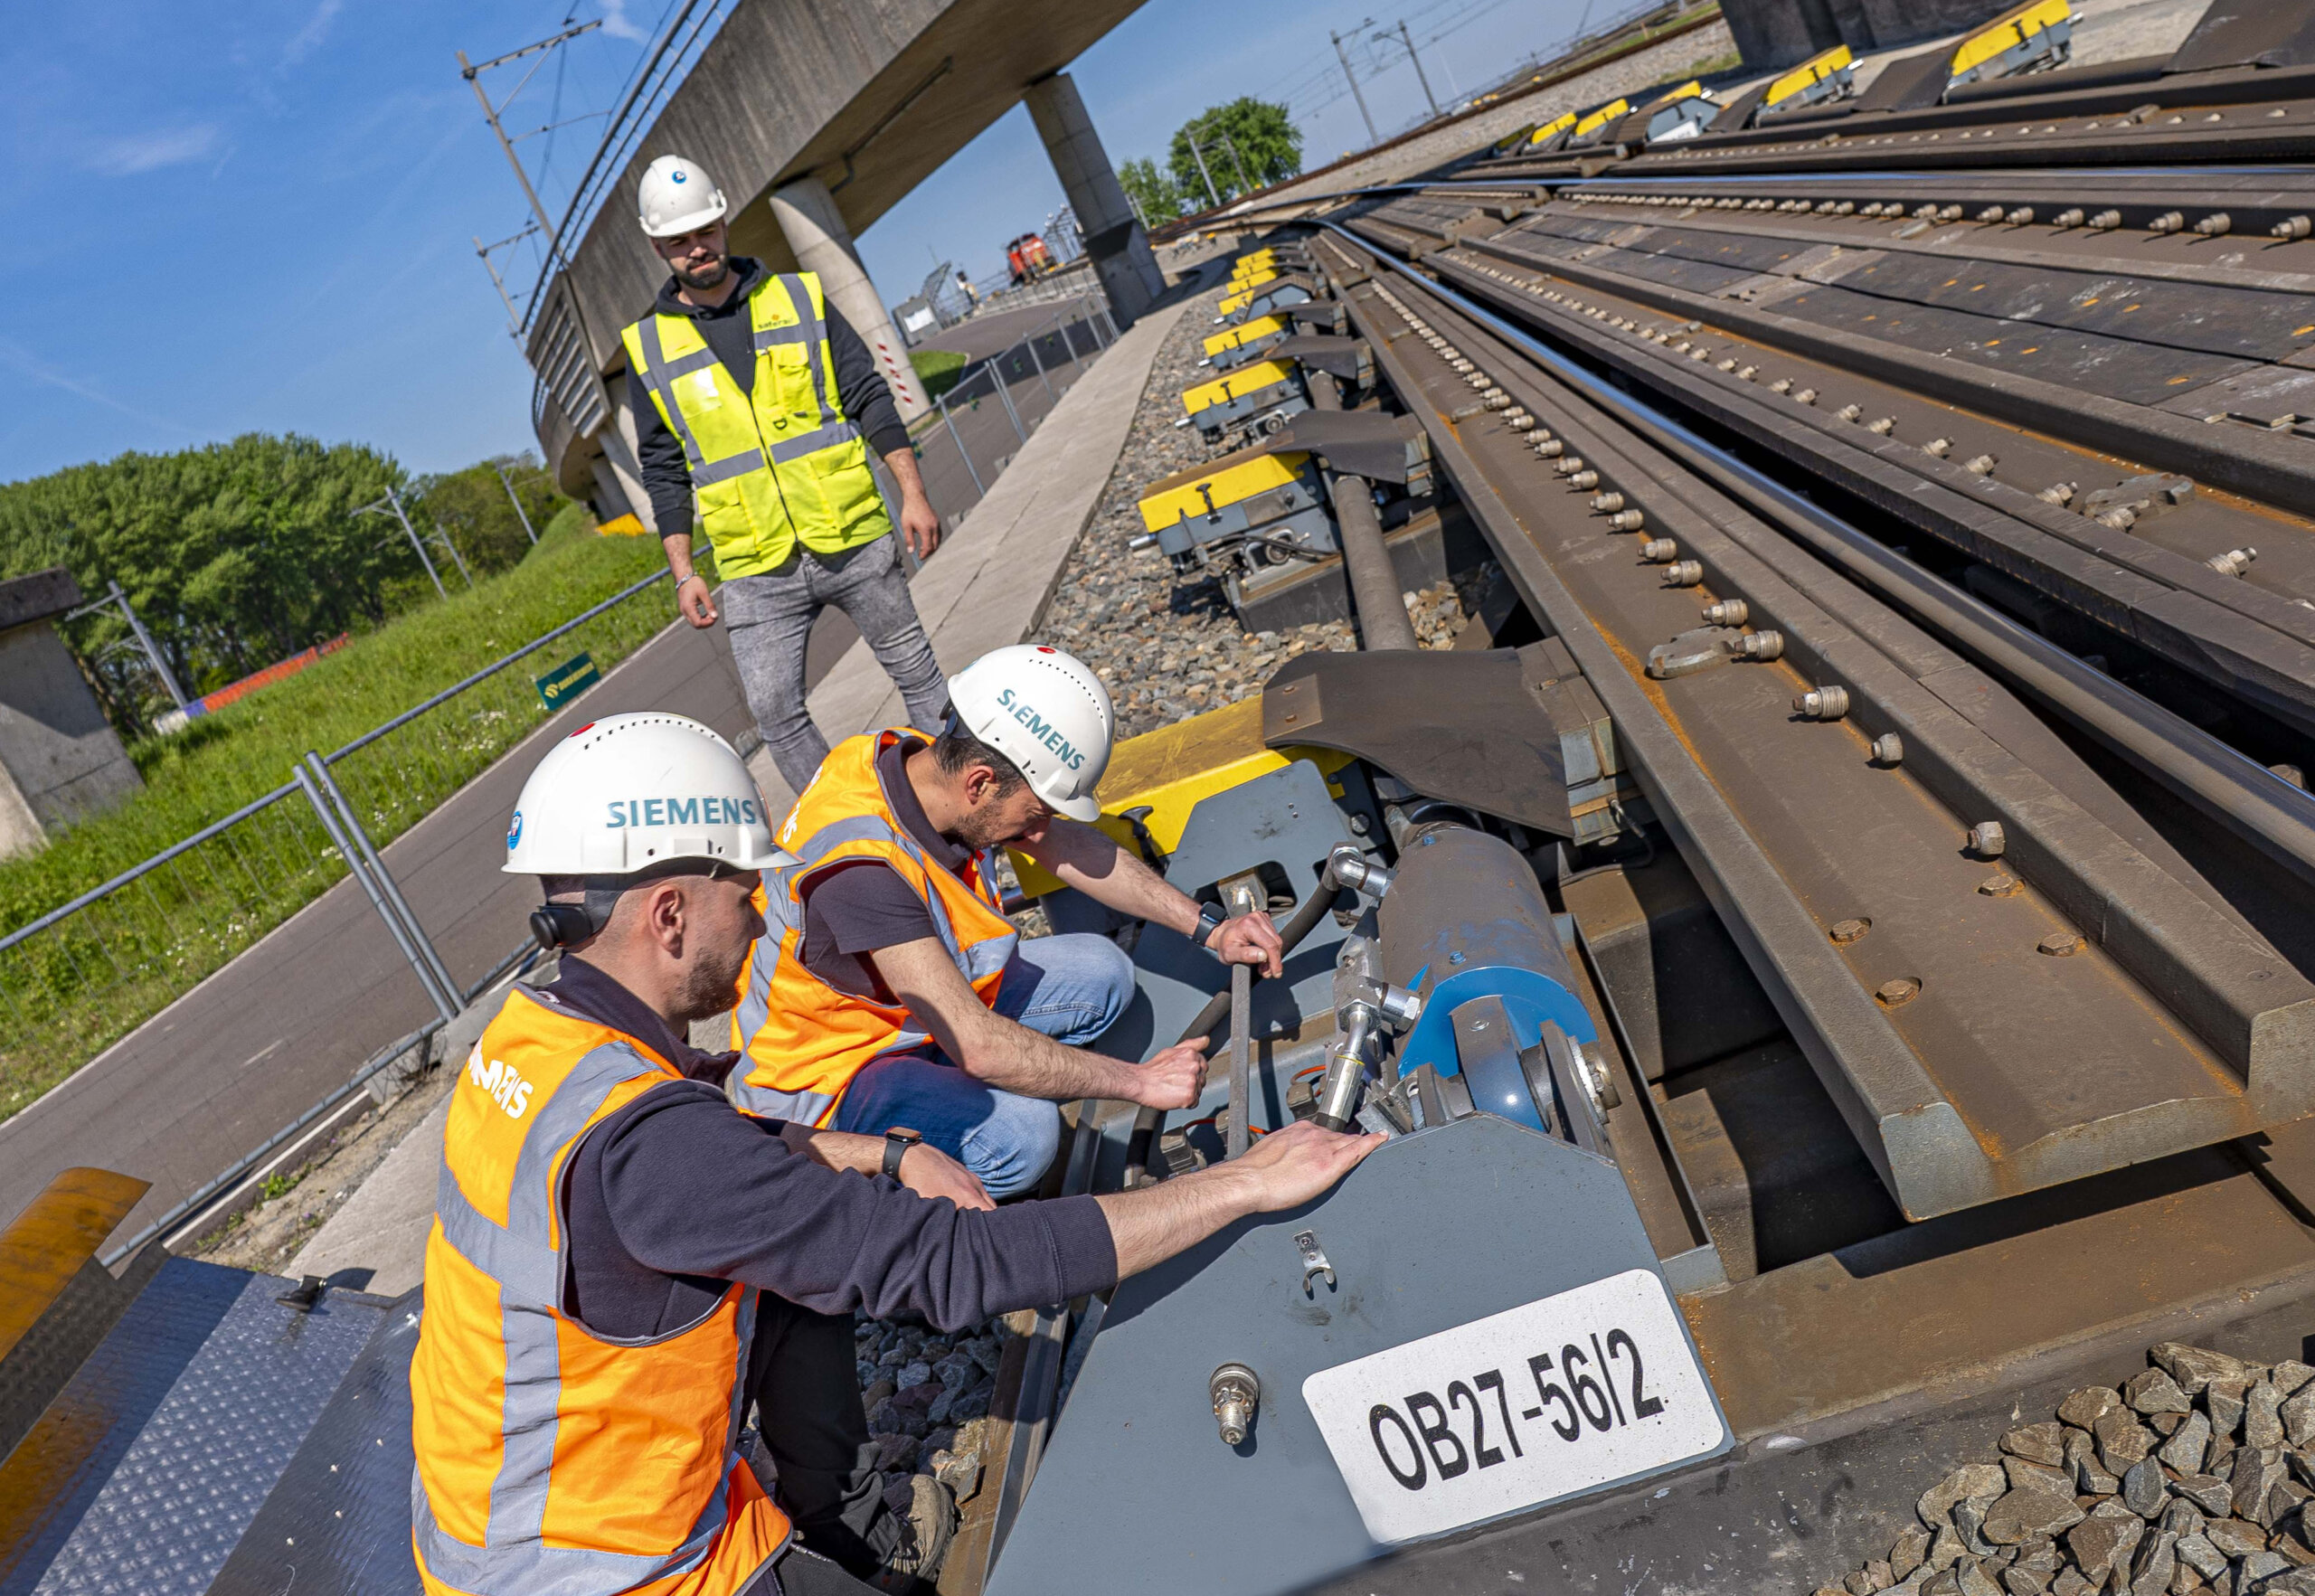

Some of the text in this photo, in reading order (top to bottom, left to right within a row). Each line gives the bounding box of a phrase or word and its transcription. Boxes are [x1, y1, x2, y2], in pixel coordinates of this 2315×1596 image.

[997, 688, 1085, 770] SIEMENS
[607, 798, 757, 828] SIEMENS
[468, 1034, 534, 1119] MENS
[1369, 1328, 1665, 1490] OB27-56/2
